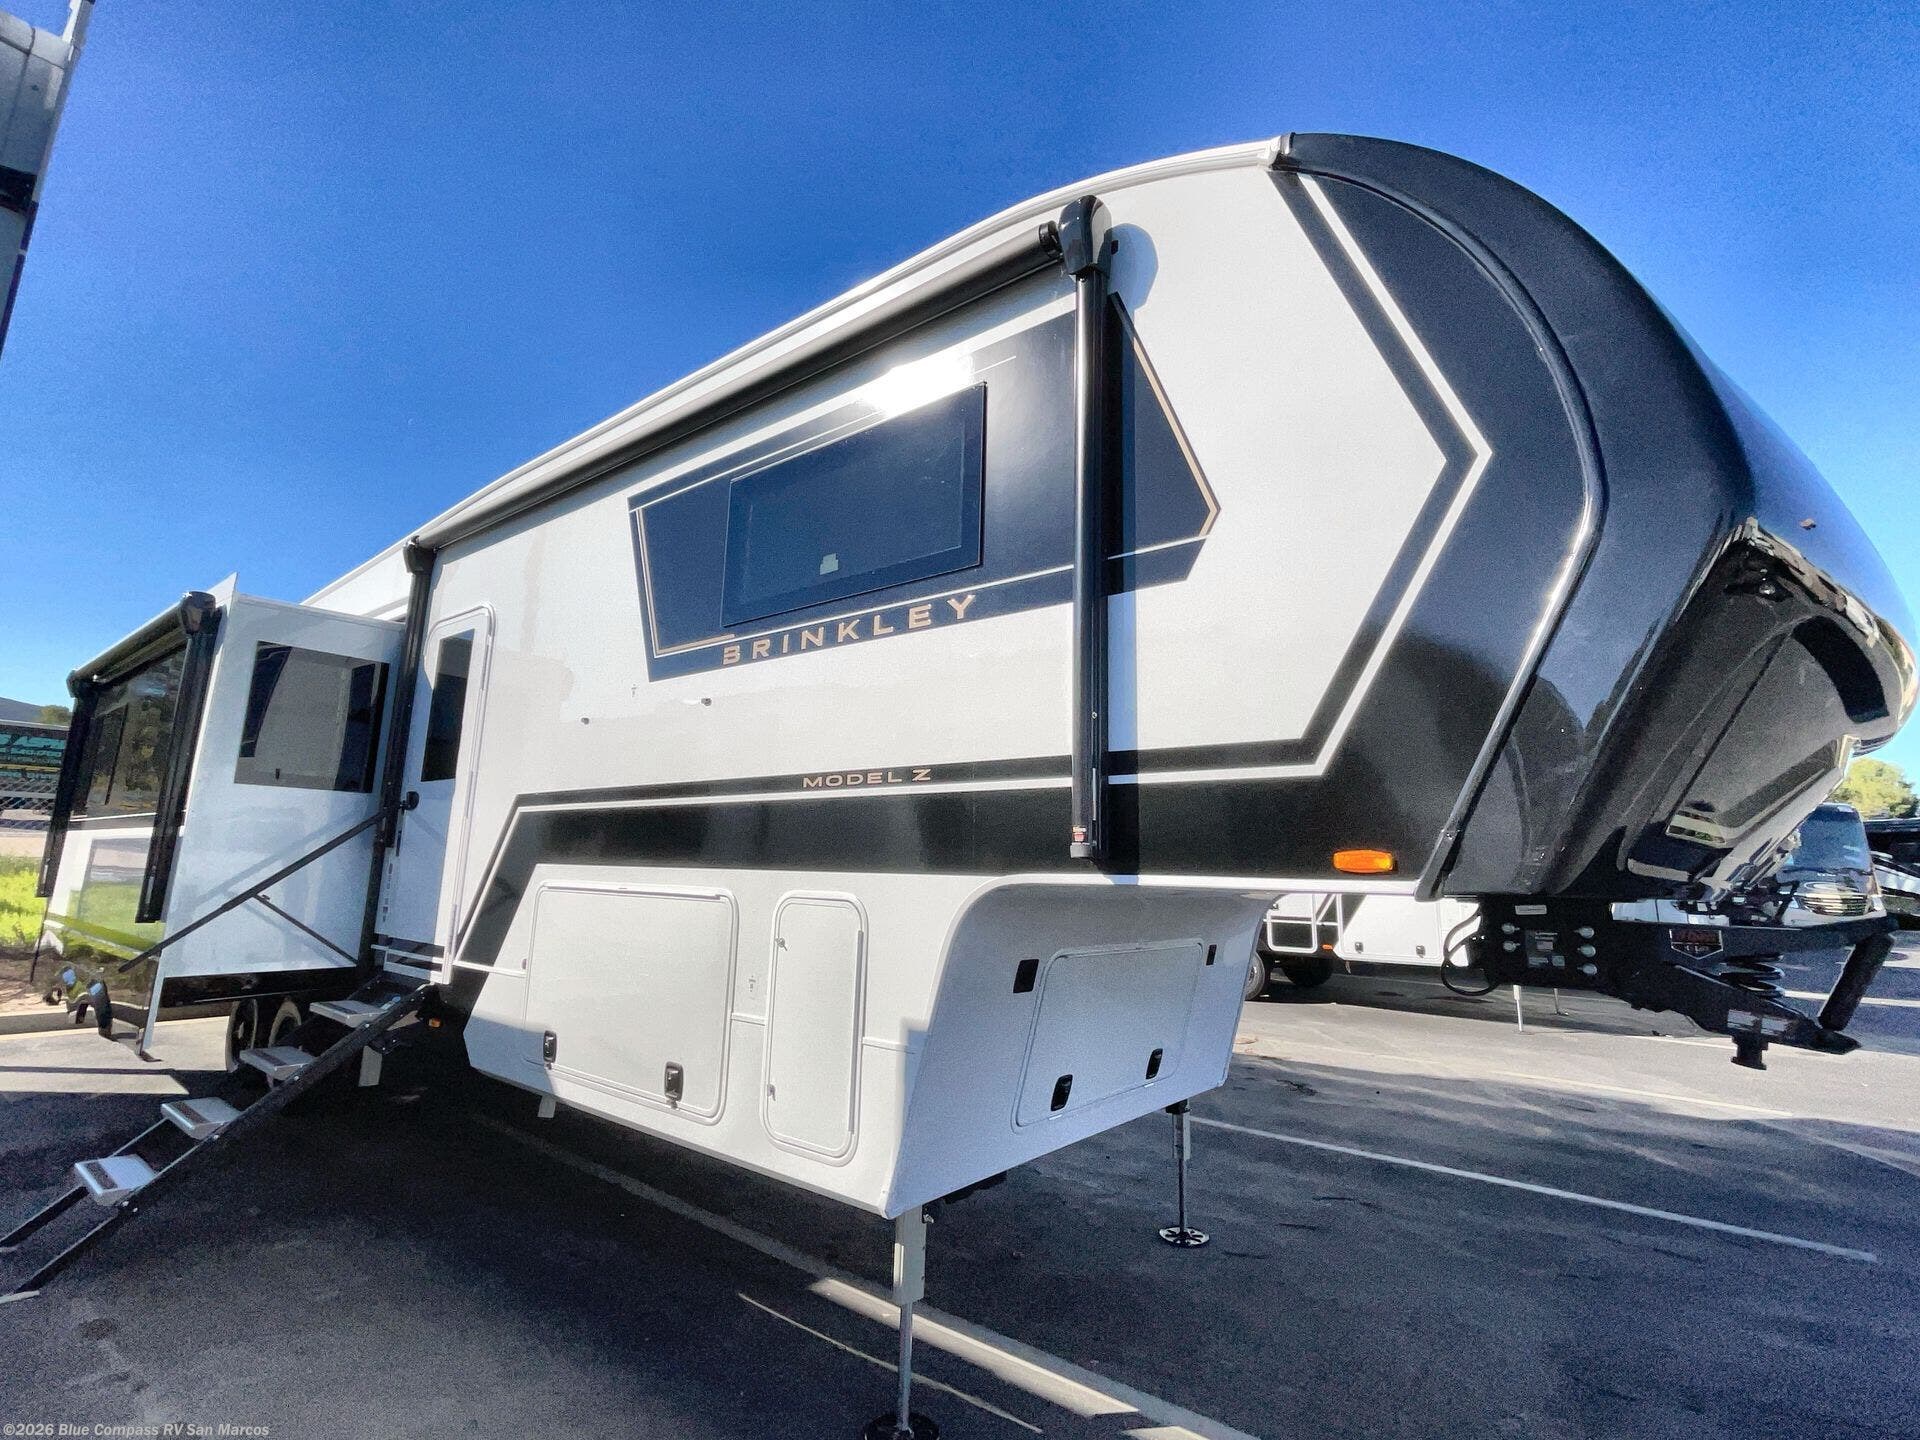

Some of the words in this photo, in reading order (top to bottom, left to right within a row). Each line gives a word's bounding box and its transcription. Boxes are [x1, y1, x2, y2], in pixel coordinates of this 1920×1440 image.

[723, 594, 976, 665] BRINKLEY
[803, 771, 902, 788] MODEL
[912, 768, 931, 782] Z
